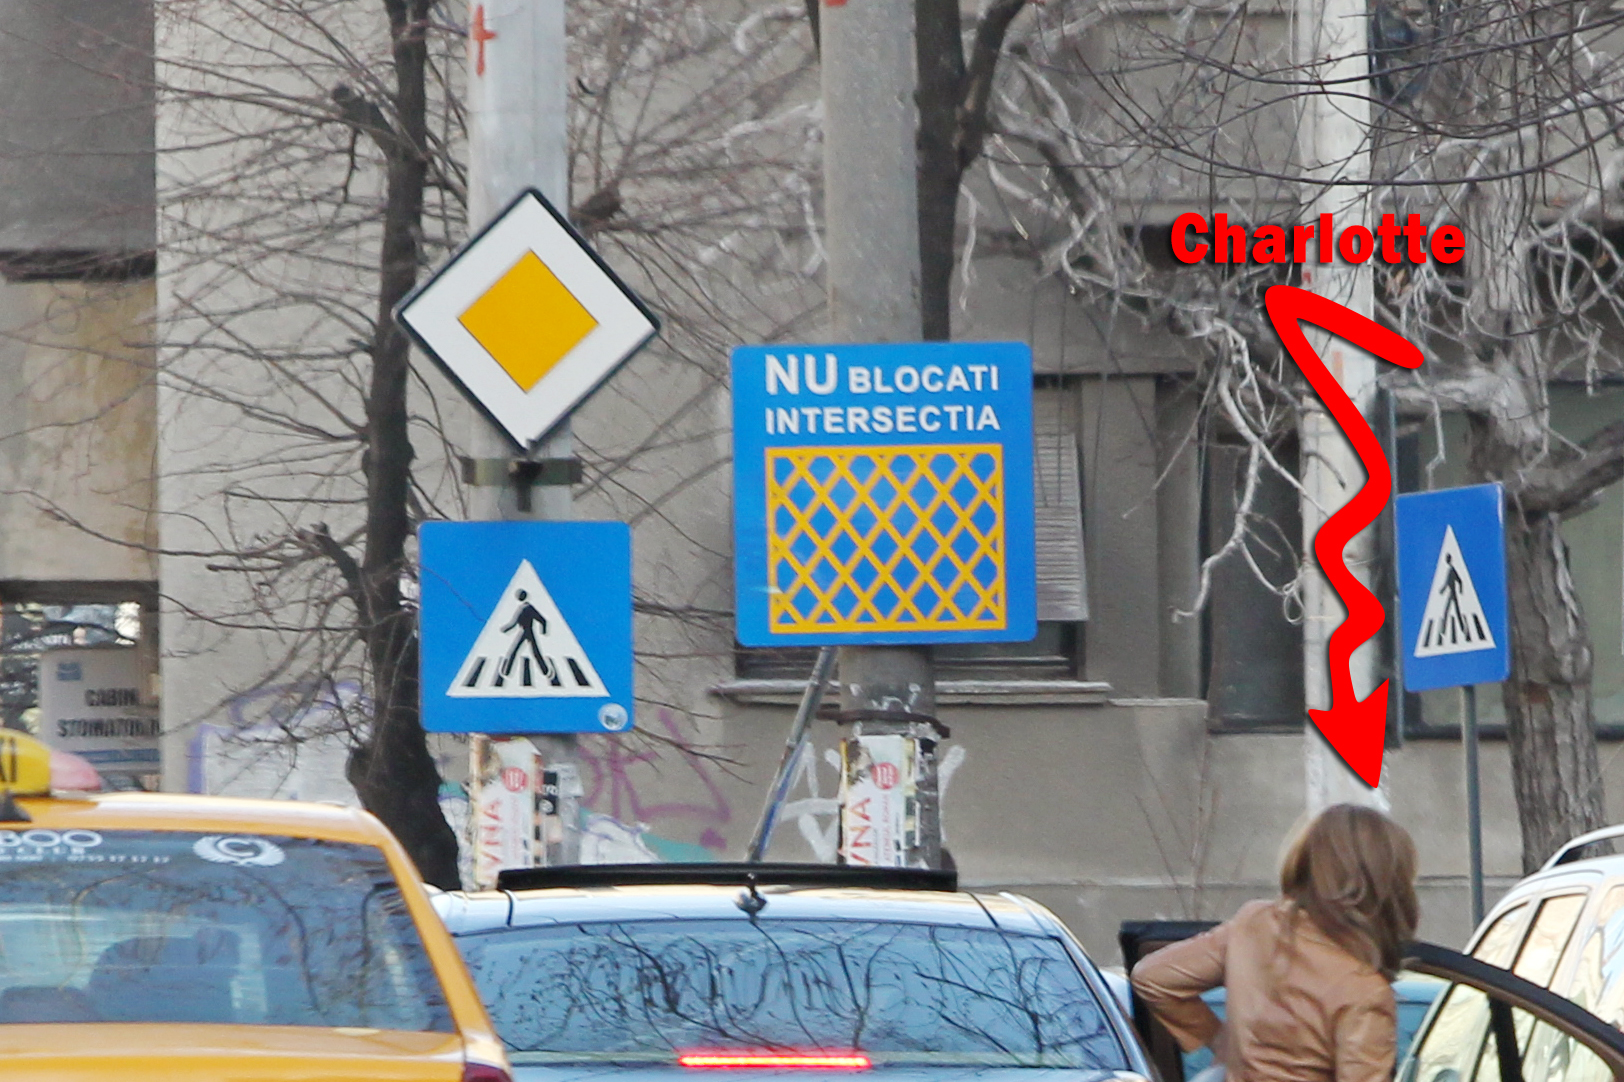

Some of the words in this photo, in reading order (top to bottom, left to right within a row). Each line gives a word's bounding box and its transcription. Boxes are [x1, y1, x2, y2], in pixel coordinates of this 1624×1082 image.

[764, 353, 838, 395] NU
[848, 364, 999, 394] BLOCATI
[765, 405, 1000, 434] INTERSECTIA
